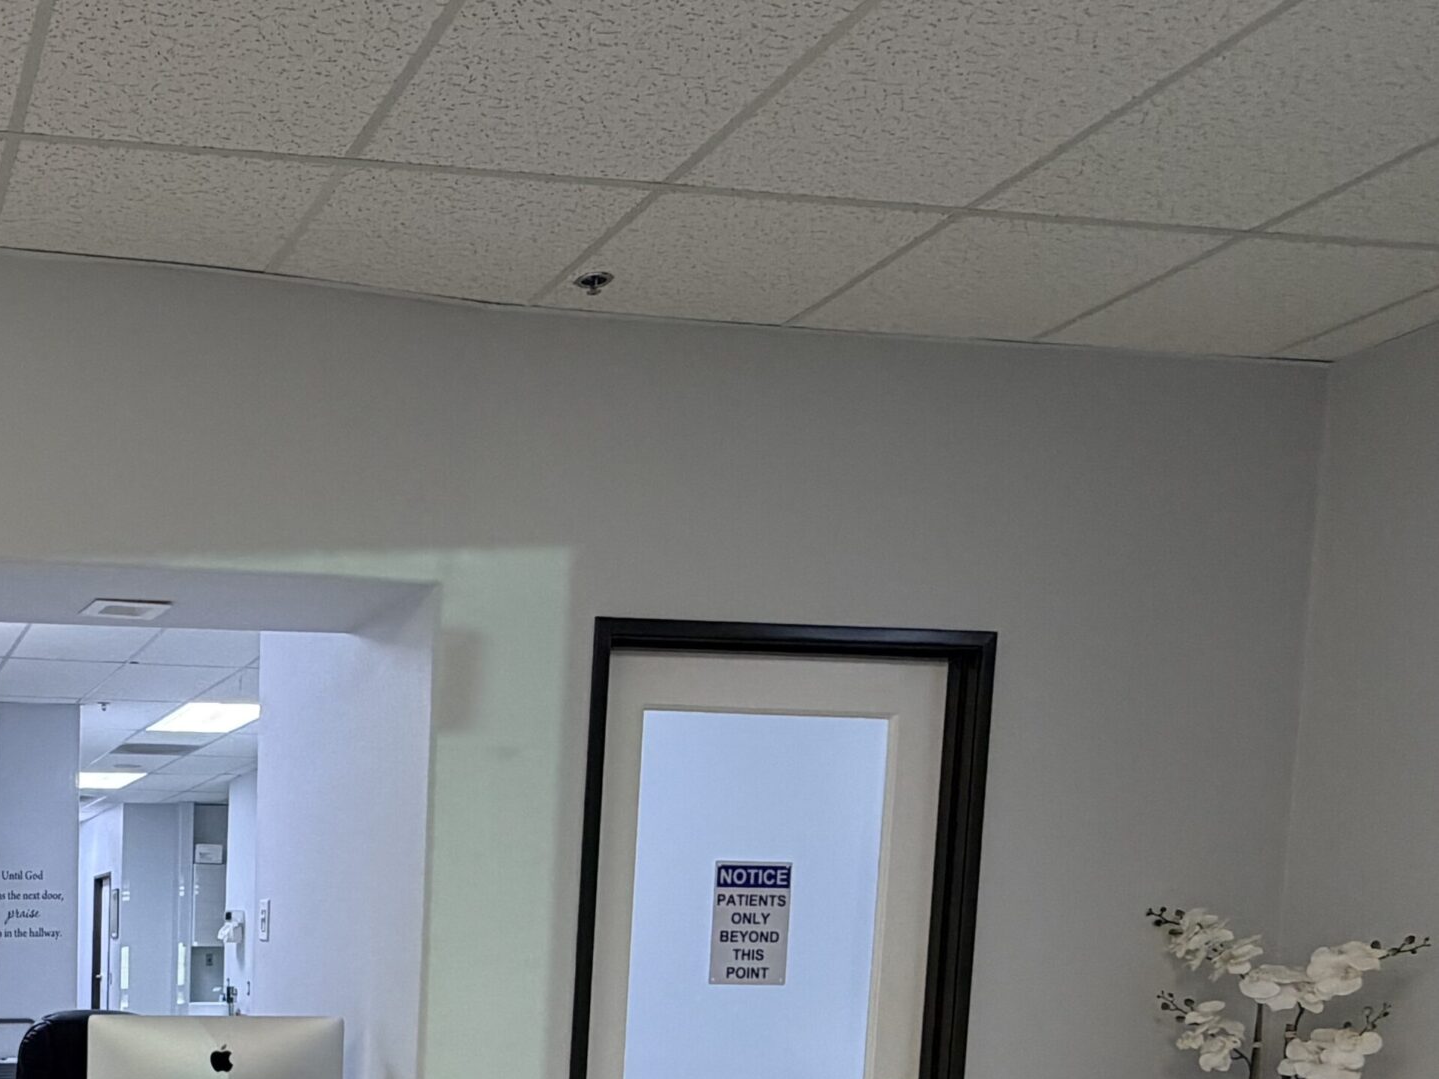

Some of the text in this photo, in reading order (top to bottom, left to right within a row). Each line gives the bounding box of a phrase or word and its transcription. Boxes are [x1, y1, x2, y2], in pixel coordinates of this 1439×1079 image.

[2, 870, 44, 880] Until God
[720, 869, 788, 885] NOTICE
[8, 890, 21, 900] the
[22, 891, 40, 900] next
[42, 890, 64, 902] door,
[717, 894, 786, 907] PATIENTS
[4, 909, 40, 926] praise
[730, 912, 771, 925] ONLY
[4, 928, 12, 938] in
[14, 928, 27, 938] the
[29, 927, 62, 940] hallway.
[719, 930, 780, 943] BEYOND
[732, 948, 765, 961] THIS
[726, 966, 770, 980] POINT
